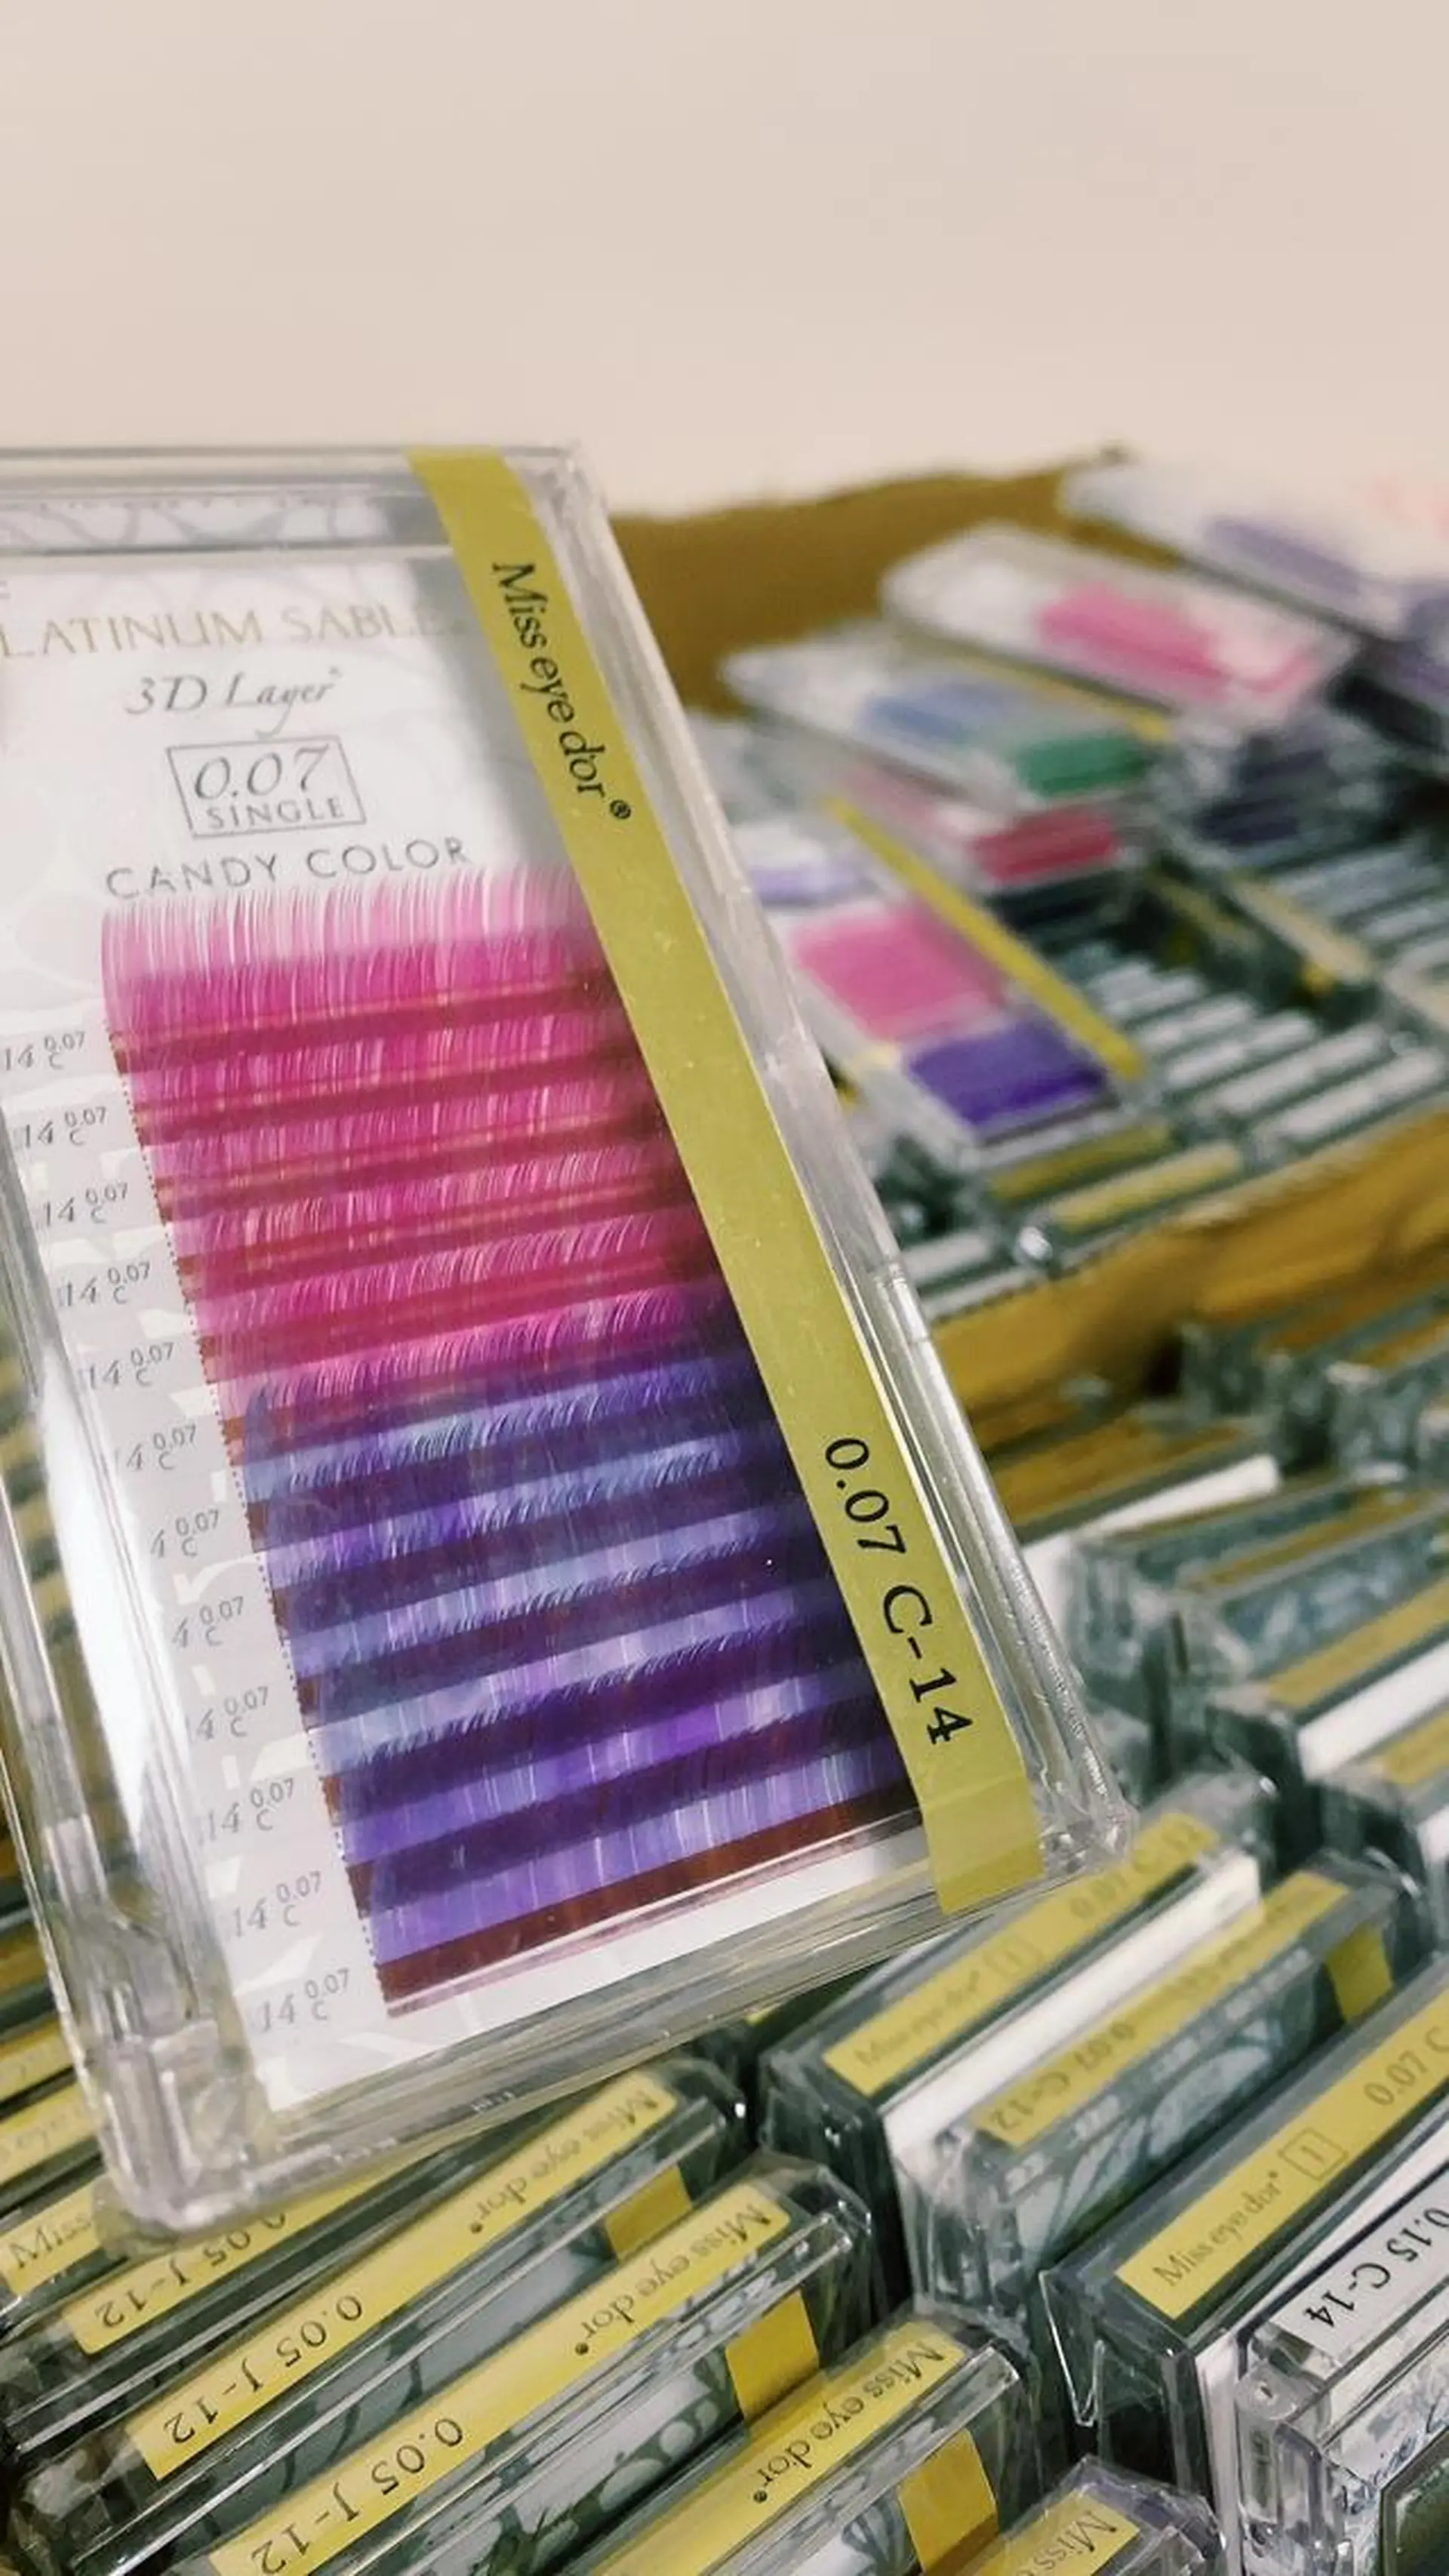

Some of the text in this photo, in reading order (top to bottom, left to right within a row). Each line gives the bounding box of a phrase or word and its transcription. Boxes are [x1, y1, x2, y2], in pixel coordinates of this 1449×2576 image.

[492, 562, 549, 649] Miss
[125, 674, 208, 715] 3D
[520, 655, 575, 723] eye
[194, 743, 329, 801] 0.07
[205, 796, 346, 830] SINGLE
[106, 836, 472, 900] CANDY COLOR
[6, 1031, 86, 1070] 14 0.07 C
[26, 1106, 107, 1148] 14 0.07 C
[45, 1182, 128, 1226] 14 0.07 C
[67, 1261, 150, 1307] 14 0.07 C
[90, 1341, 174, 1390] 14 0.07 C
[153, 1423, 196, 1451] 0.07
[158, 1451, 176, 1471] C
[175, 1509, 220, 1537] 0.07
[180, 1536, 198, 1558] C
[198, 1596, 245, 1626] 0.07
[826, 1437, 974, 1746] 0.07 C-14
[205, 1625, 223, 1647] C
[223, 1685, 269, 1716] 0.07
[229, 1716, 248, 1737] C
[207, 1777, 295, 1842] 14 0.07 C
[232, 1870, 323, 1938] 14 0.07 C
[261, 1968, 350, 2033] 14 0.07 C
[1152, 2240, 1214, 2287] Miss
[1363, 2048, 1429, 2107] 0.07
[8, 2221, 92, 2270] Miss
[689, 2202, 771, 2257] Miss
[635, 2257, 691, 2297] eye
[1305, 2208, 1449, 2329] 0.15 C-14
[162, 2295, 363, 2444] 0.05 J-12
[862, 2341, 945, 2399] Miss
[810, 2396, 865, 2440] eye
[251, 2418, 463, 2574] 0.05 J-12
[1033, 2510, 1117, 2570] Miss
